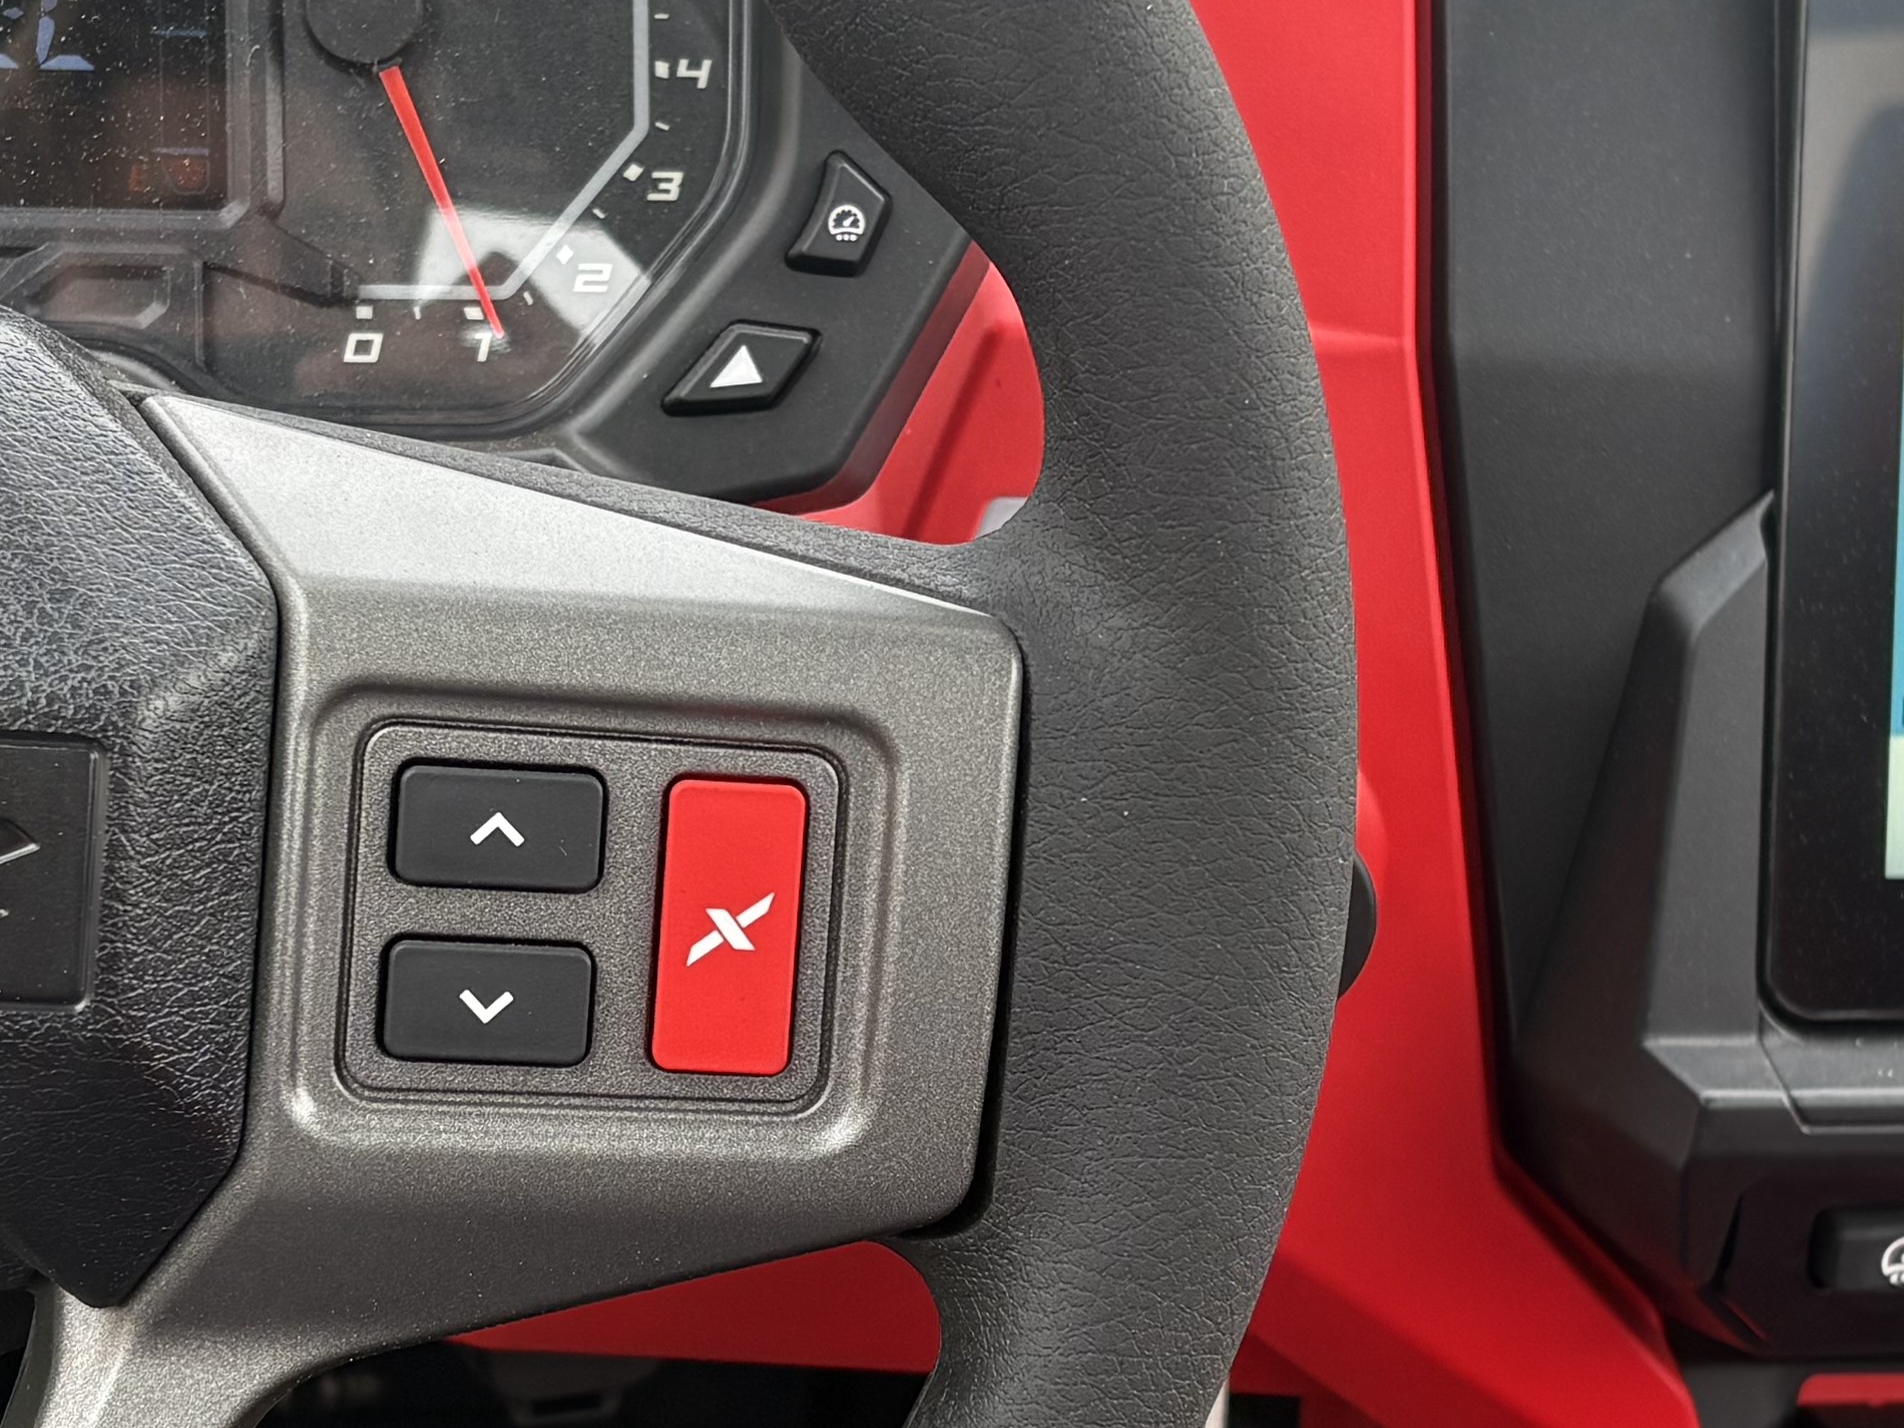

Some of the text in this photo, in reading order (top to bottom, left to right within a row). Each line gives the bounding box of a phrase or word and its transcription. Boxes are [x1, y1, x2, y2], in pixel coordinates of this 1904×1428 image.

[675, 60, 714, 90] 4
[647, 171, 684, 200] 3
[574, 264, 613, 293] 2
[342, 334, 384, 363] 0
[470, 334, 498, 361] 1
